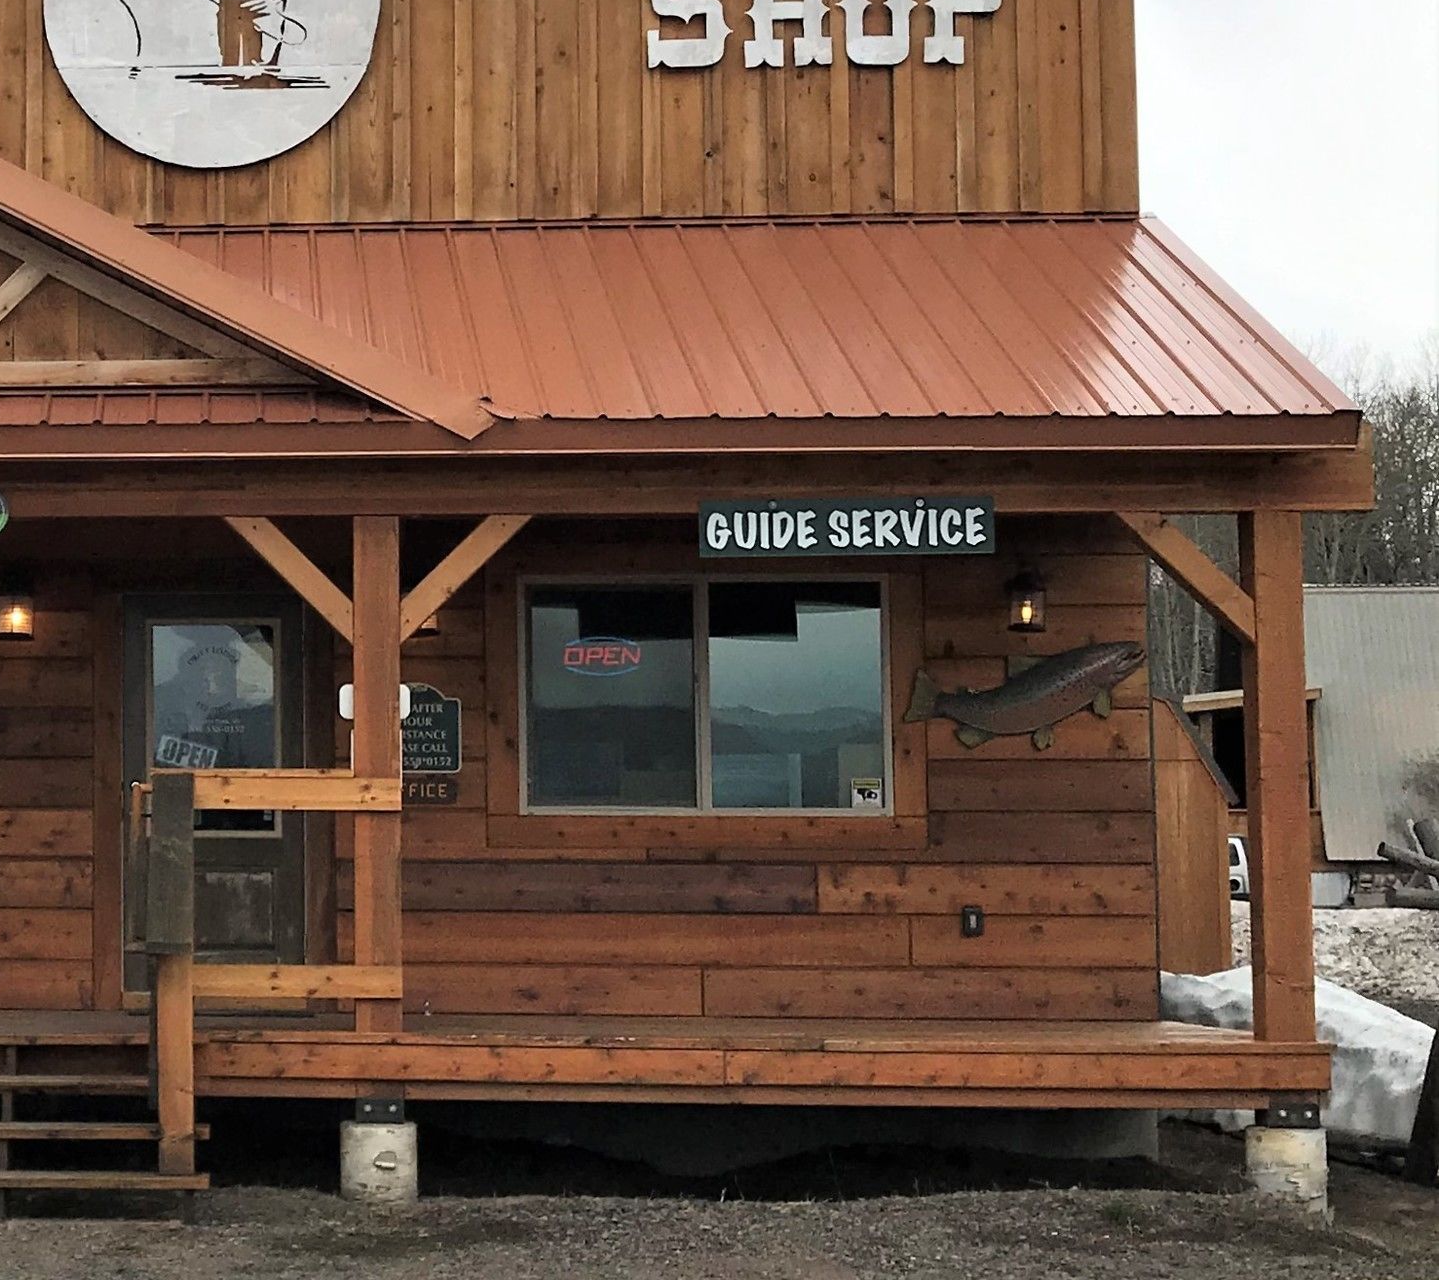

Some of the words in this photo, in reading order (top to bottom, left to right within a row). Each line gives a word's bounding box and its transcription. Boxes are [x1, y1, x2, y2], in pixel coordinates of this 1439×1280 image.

[706, 509, 819, 551] GUIDE
[828, 507, 988, 548] SERVICE
[564, 647, 641, 665] OPEN
[412, 704, 444, 713] AFTER
[162, 738, 216, 768] OPEN
[421, 743, 448, 752] CALL
[404, 783, 448, 798] FICE
